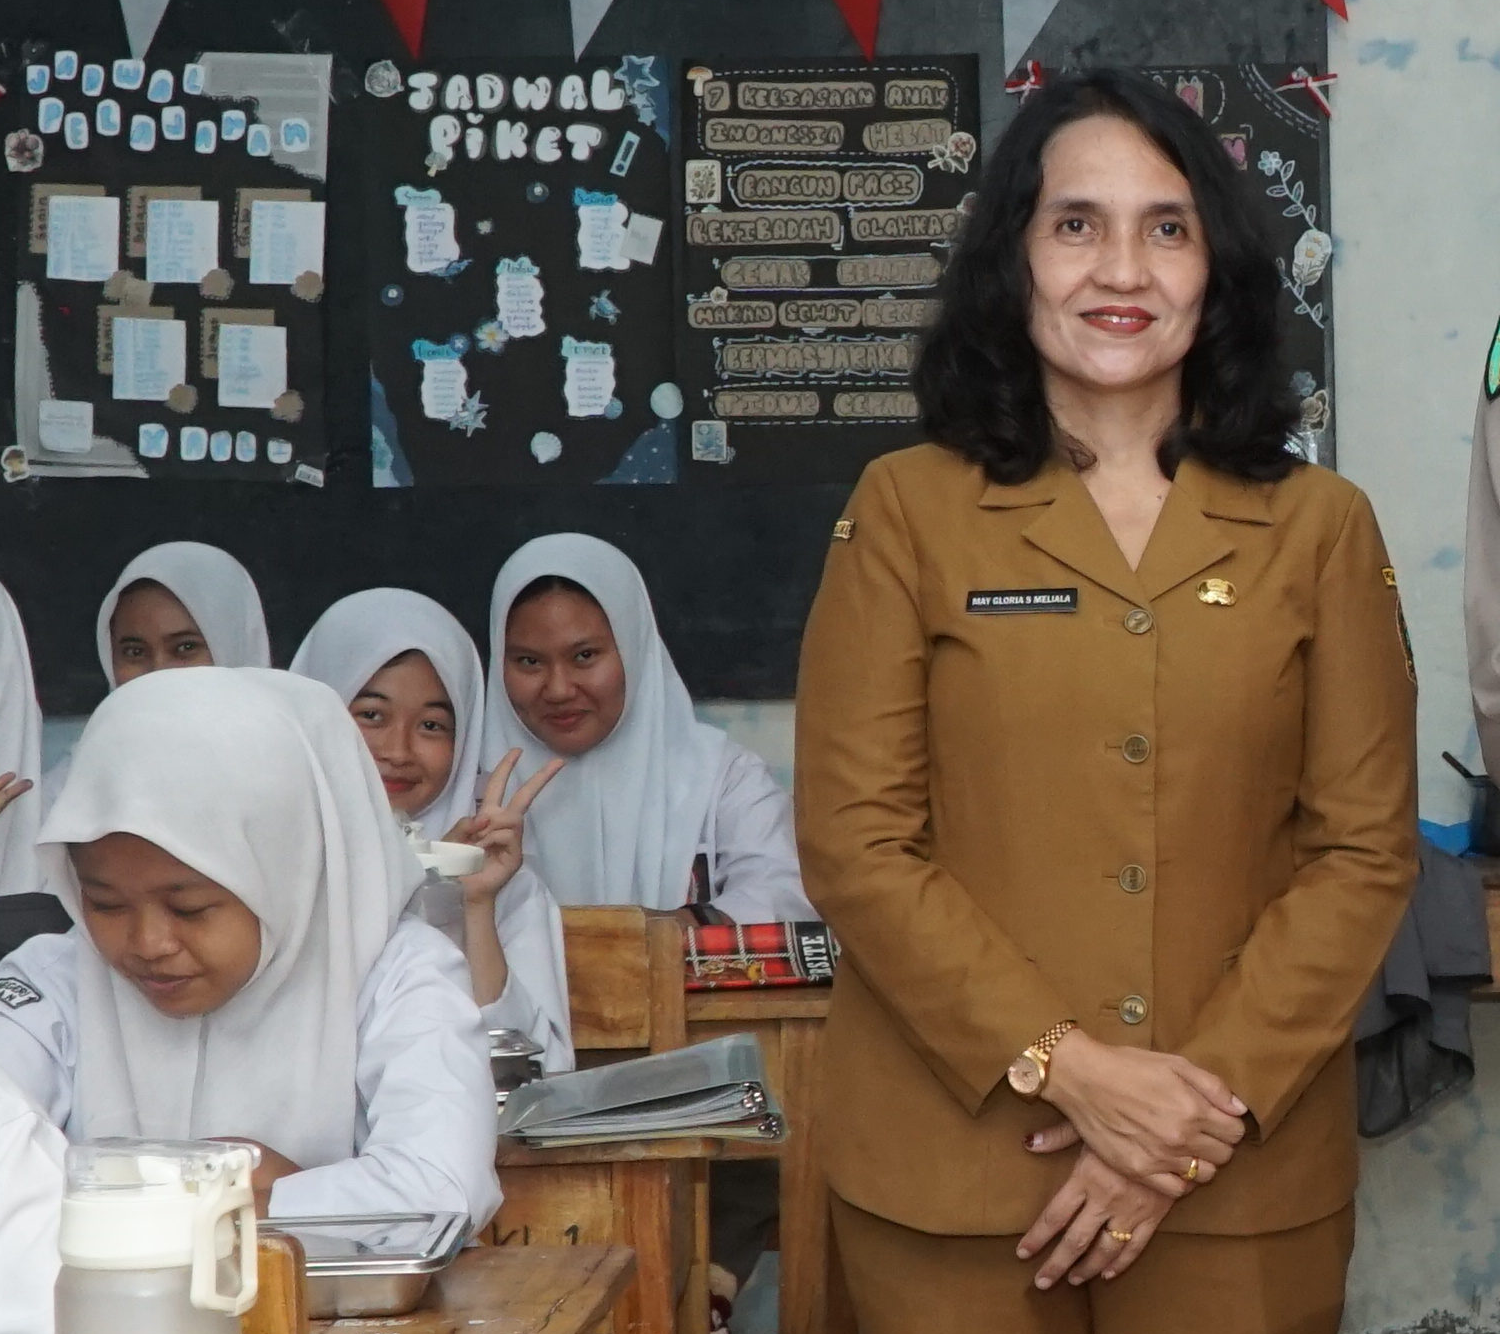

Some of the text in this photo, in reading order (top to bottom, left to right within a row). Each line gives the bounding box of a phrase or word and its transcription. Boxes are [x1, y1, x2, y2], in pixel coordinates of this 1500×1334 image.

[408, 69, 624, 111] JADWAL
[708, 86, 725, 108] 7
[709, 121, 947, 149] INDONESIA HEBAT
[740, 173, 836, 199] BANGUN
[849, 171, 914, 197] PAGI
[857, 213, 960, 238] OLAHRAG
[726, 344, 913, 369] BERMASYARAKA
[972, 596, 991, 606] MAY
[992, 596, 1024, 606] GLORIA
[1033, 594, 1071, 605] MELIALA
